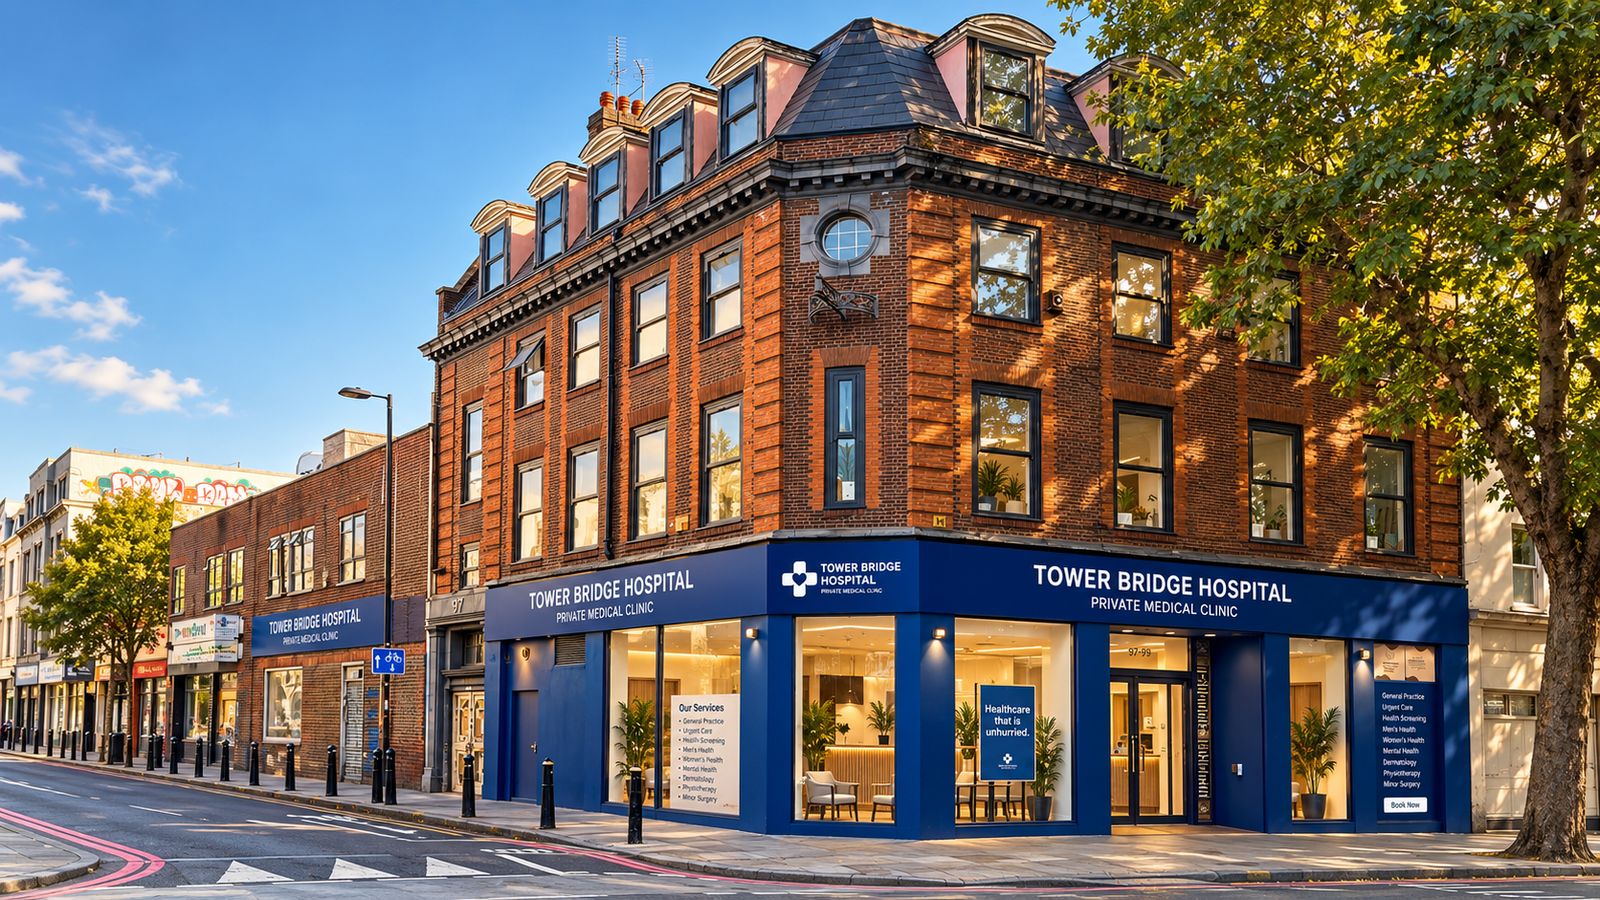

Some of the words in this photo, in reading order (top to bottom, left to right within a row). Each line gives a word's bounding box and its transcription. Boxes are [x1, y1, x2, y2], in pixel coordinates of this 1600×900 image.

[821, 563, 858, 573] TOWER
[861, 561, 901, 572] BRIDGE
[821, 575, 876, 586] HOSPITAL
[1033, 564, 1111, 590] TOWER
[1118, 571, 1193, 596] BRIDGE
[1199, 578, 1292, 603] HOSPITAL
[529, 588, 570, 610] TOWER
[574, 580, 620, 604] BRIDGE
[624, 569, 694, 598] HOSPITAL
[452, 597, 464, 613] 97
[1091, 596, 1140, 612] PRIVATE
[1144, 600, 1197, 615] MEDICAL
[1200, 603, 1238, 618] CLINIC
[556, 609, 586, 623] PRIVATE
[588, 605, 623, 621] MEDICAL
[625, 601, 654, 615] CLINIC
[269, 620, 293, 635] TOWER
[293, 614, 320, 631] BRIDGE
[322, 608, 361, 627] HOSPITAL
[1129, 647, 1151, 657] 97-99
[679, 703, 692, 712] Our
[693, 703, 725, 712] Services
[985, 704, 1031, 714] Healthcare
[994, 716, 1012, 725] that
[1013, 716, 1021, 725] is
[1400, 715, 1426, 723] Screening
[985, 727, 1030, 737] unhurried.
[1383, 758, 1417, 767] Dermatology
[1383, 769, 1421, 778] Physiotherapy
[1399, 780, 1420, 789] Surgery
[697, 794, 718, 804] Surgery
